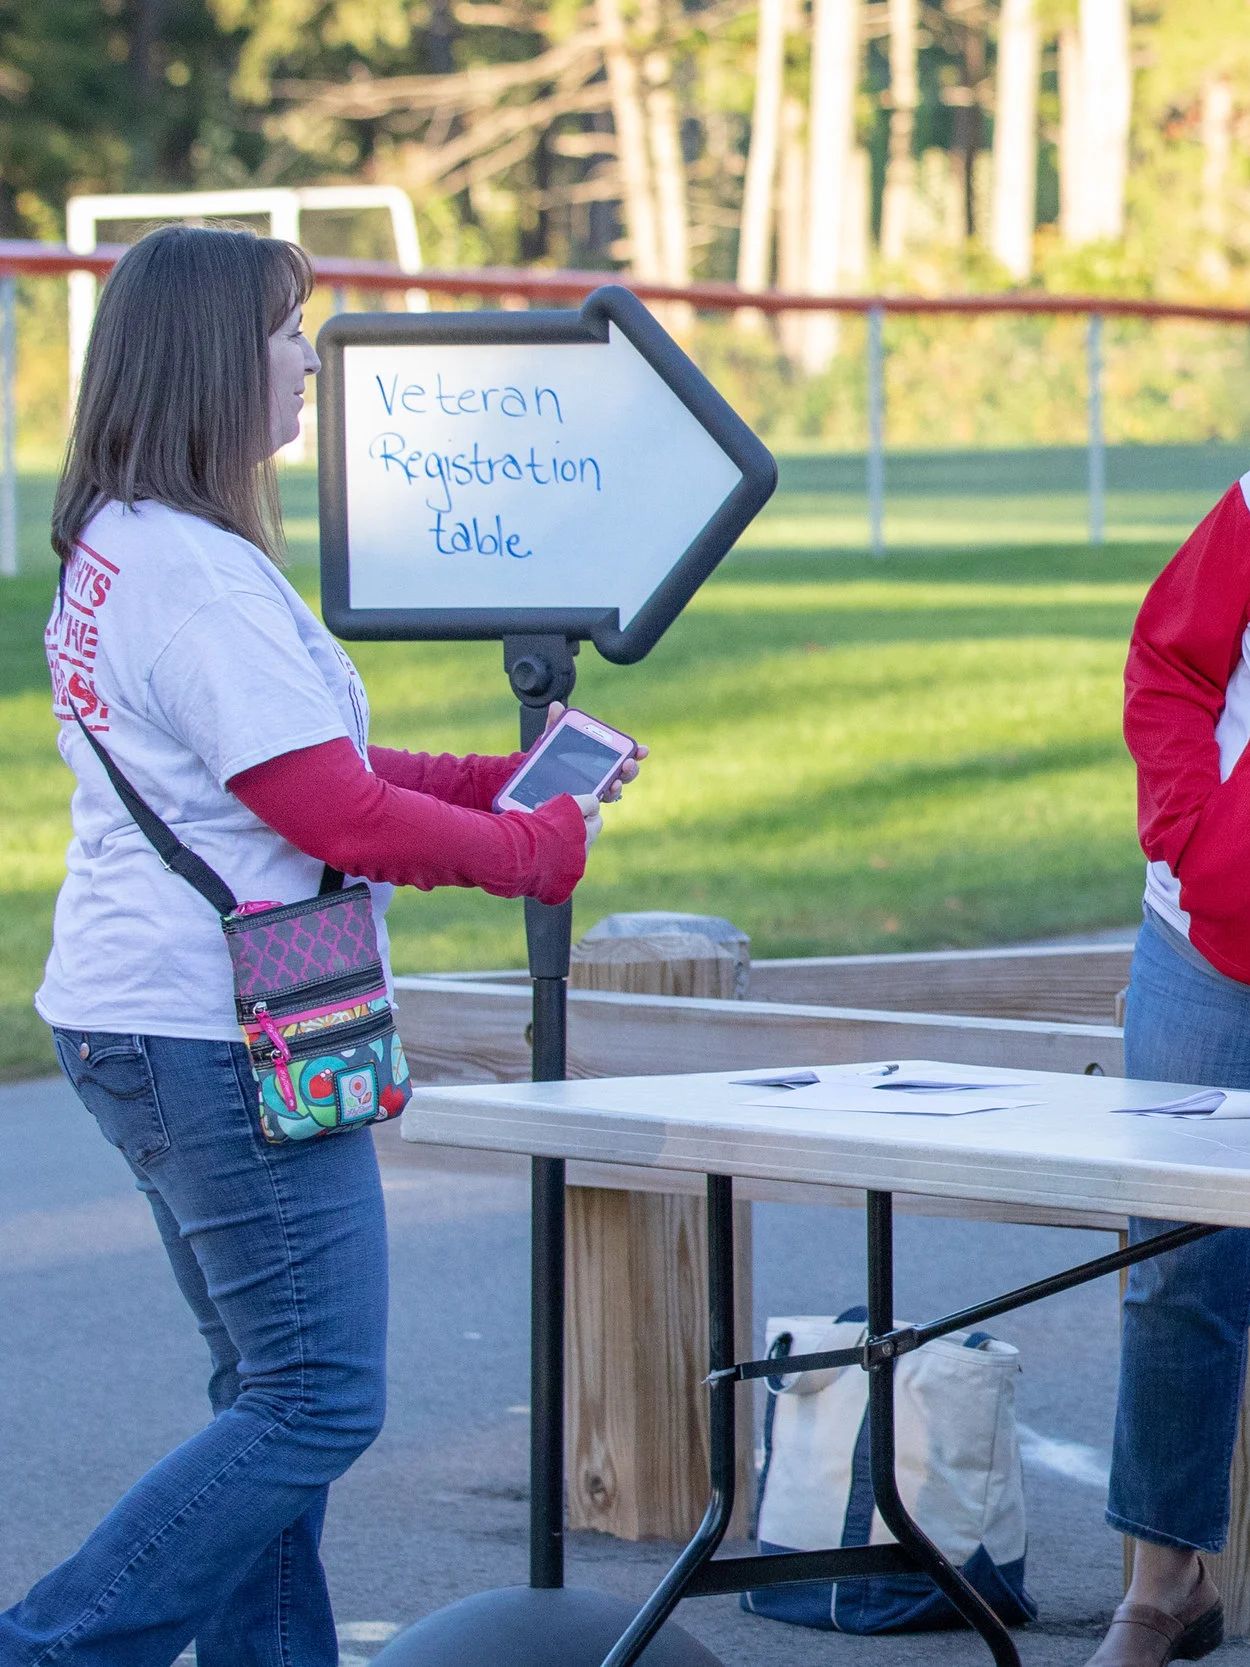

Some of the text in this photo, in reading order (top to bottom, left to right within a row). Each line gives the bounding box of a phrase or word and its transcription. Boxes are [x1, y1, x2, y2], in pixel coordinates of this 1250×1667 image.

[376, 372, 564, 423] Veteran
[368, 432, 602, 514] Registration
[428, 511, 533, 558] table
